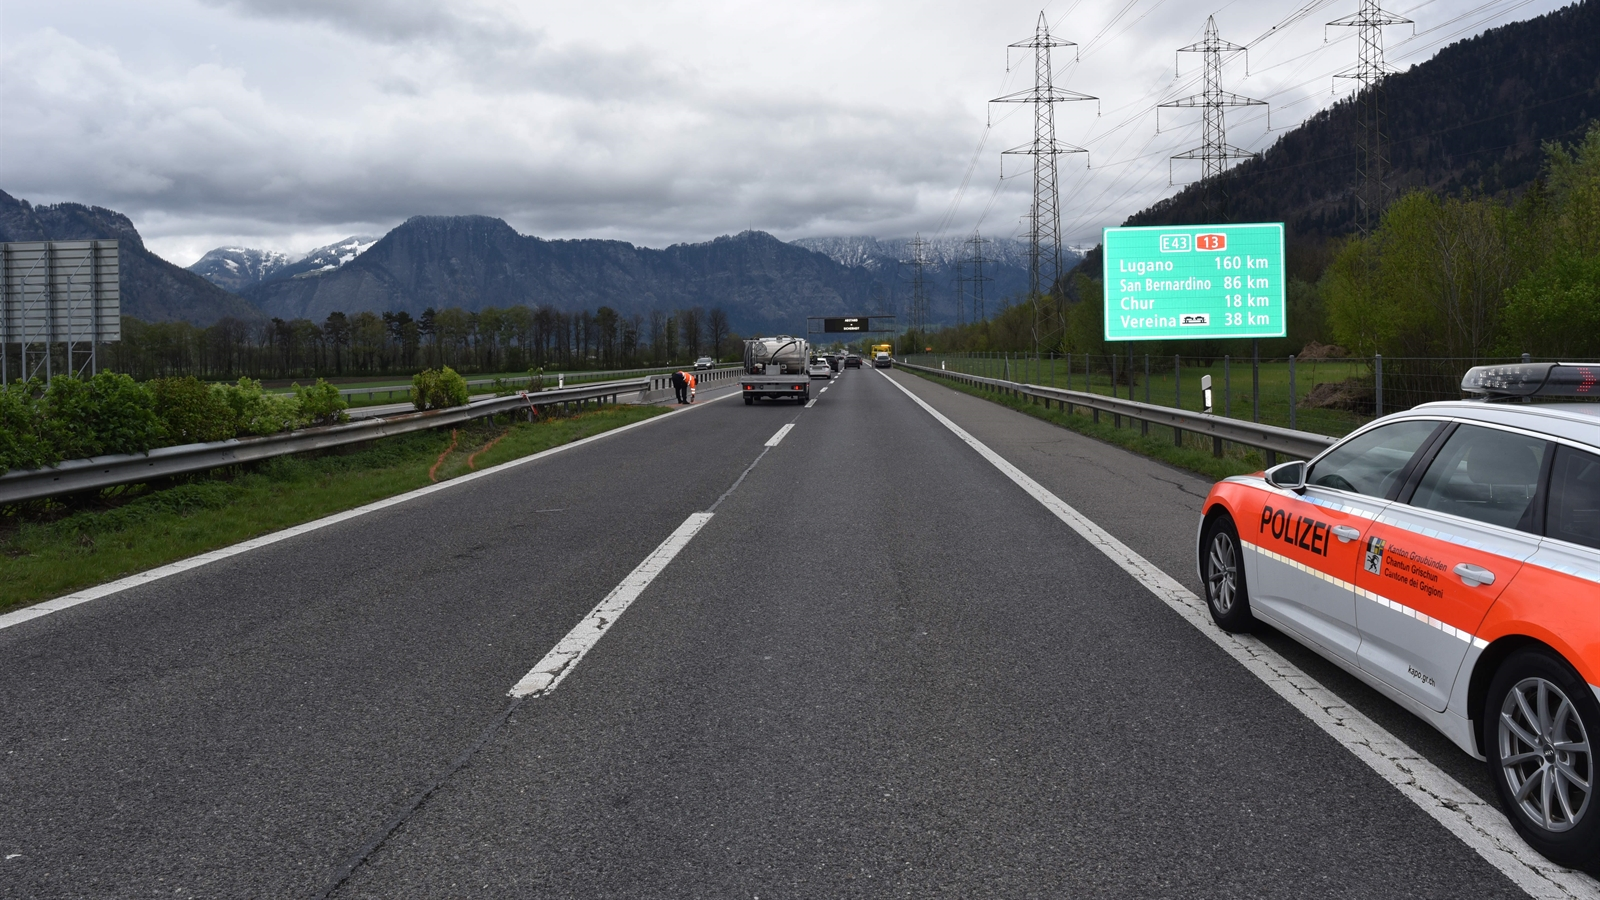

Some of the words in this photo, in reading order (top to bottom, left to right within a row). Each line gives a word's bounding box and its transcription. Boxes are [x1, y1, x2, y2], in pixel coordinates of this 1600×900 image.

[1203, 236, 1219, 249] 13
[1119, 259, 1174, 275] Lugano
[1215, 256, 1241, 270] 160
[1247, 255, 1269, 269] km
[1120, 279, 1141, 292] San
[1146, 277, 1212, 291] Bernardino
[1223, 276, 1241, 289] 86
[1247, 275, 1269, 289] km
[1120, 297, 1155, 310] Chur
[1225, 294, 1242, 307] 18
[1248, 294, 1269, 307] km
[1121, 314, 1176, 328] Vereina
[1224, 313, 1242, 326] 38
[1248, 312, 1270, 325] km
[1260, 505, 1331, 557] POLIZEI
[1386, 556, 1410, 571] Chantun
[1411, 564, 1439, 582] Grischun
[1387, 544, 1409, 558] Kanton
[1409, 551, 1448, 572] Graubünden
[1384, 568, 1408, 584] Cantone
[1409, 578, 1419, 588] dei
[1419, 581, 1444, 599] Grigioni
[1407, 664, 1436, 688] kapo.gr.ch
